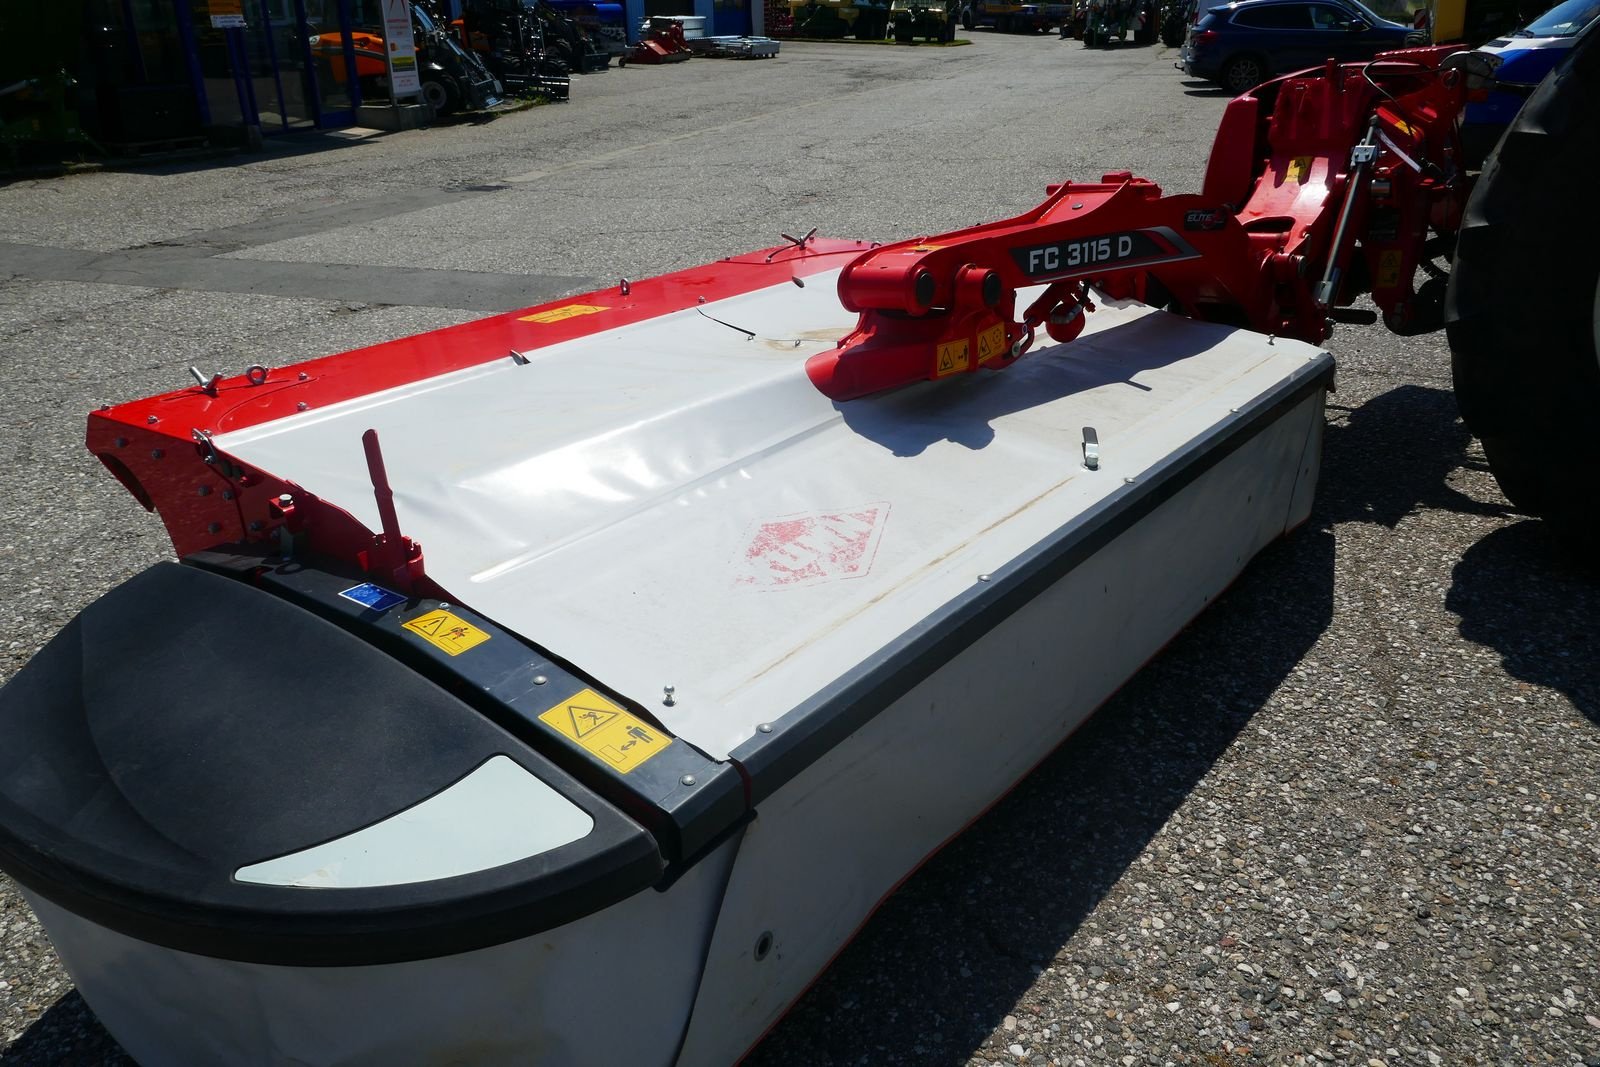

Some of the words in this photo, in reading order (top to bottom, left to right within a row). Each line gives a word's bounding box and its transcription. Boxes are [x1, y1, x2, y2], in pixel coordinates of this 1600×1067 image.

[1029, 246, 1059, 273] FC
[1067, 236, 1111, 266] 3115
[1118, 235, 1132, 258] D
